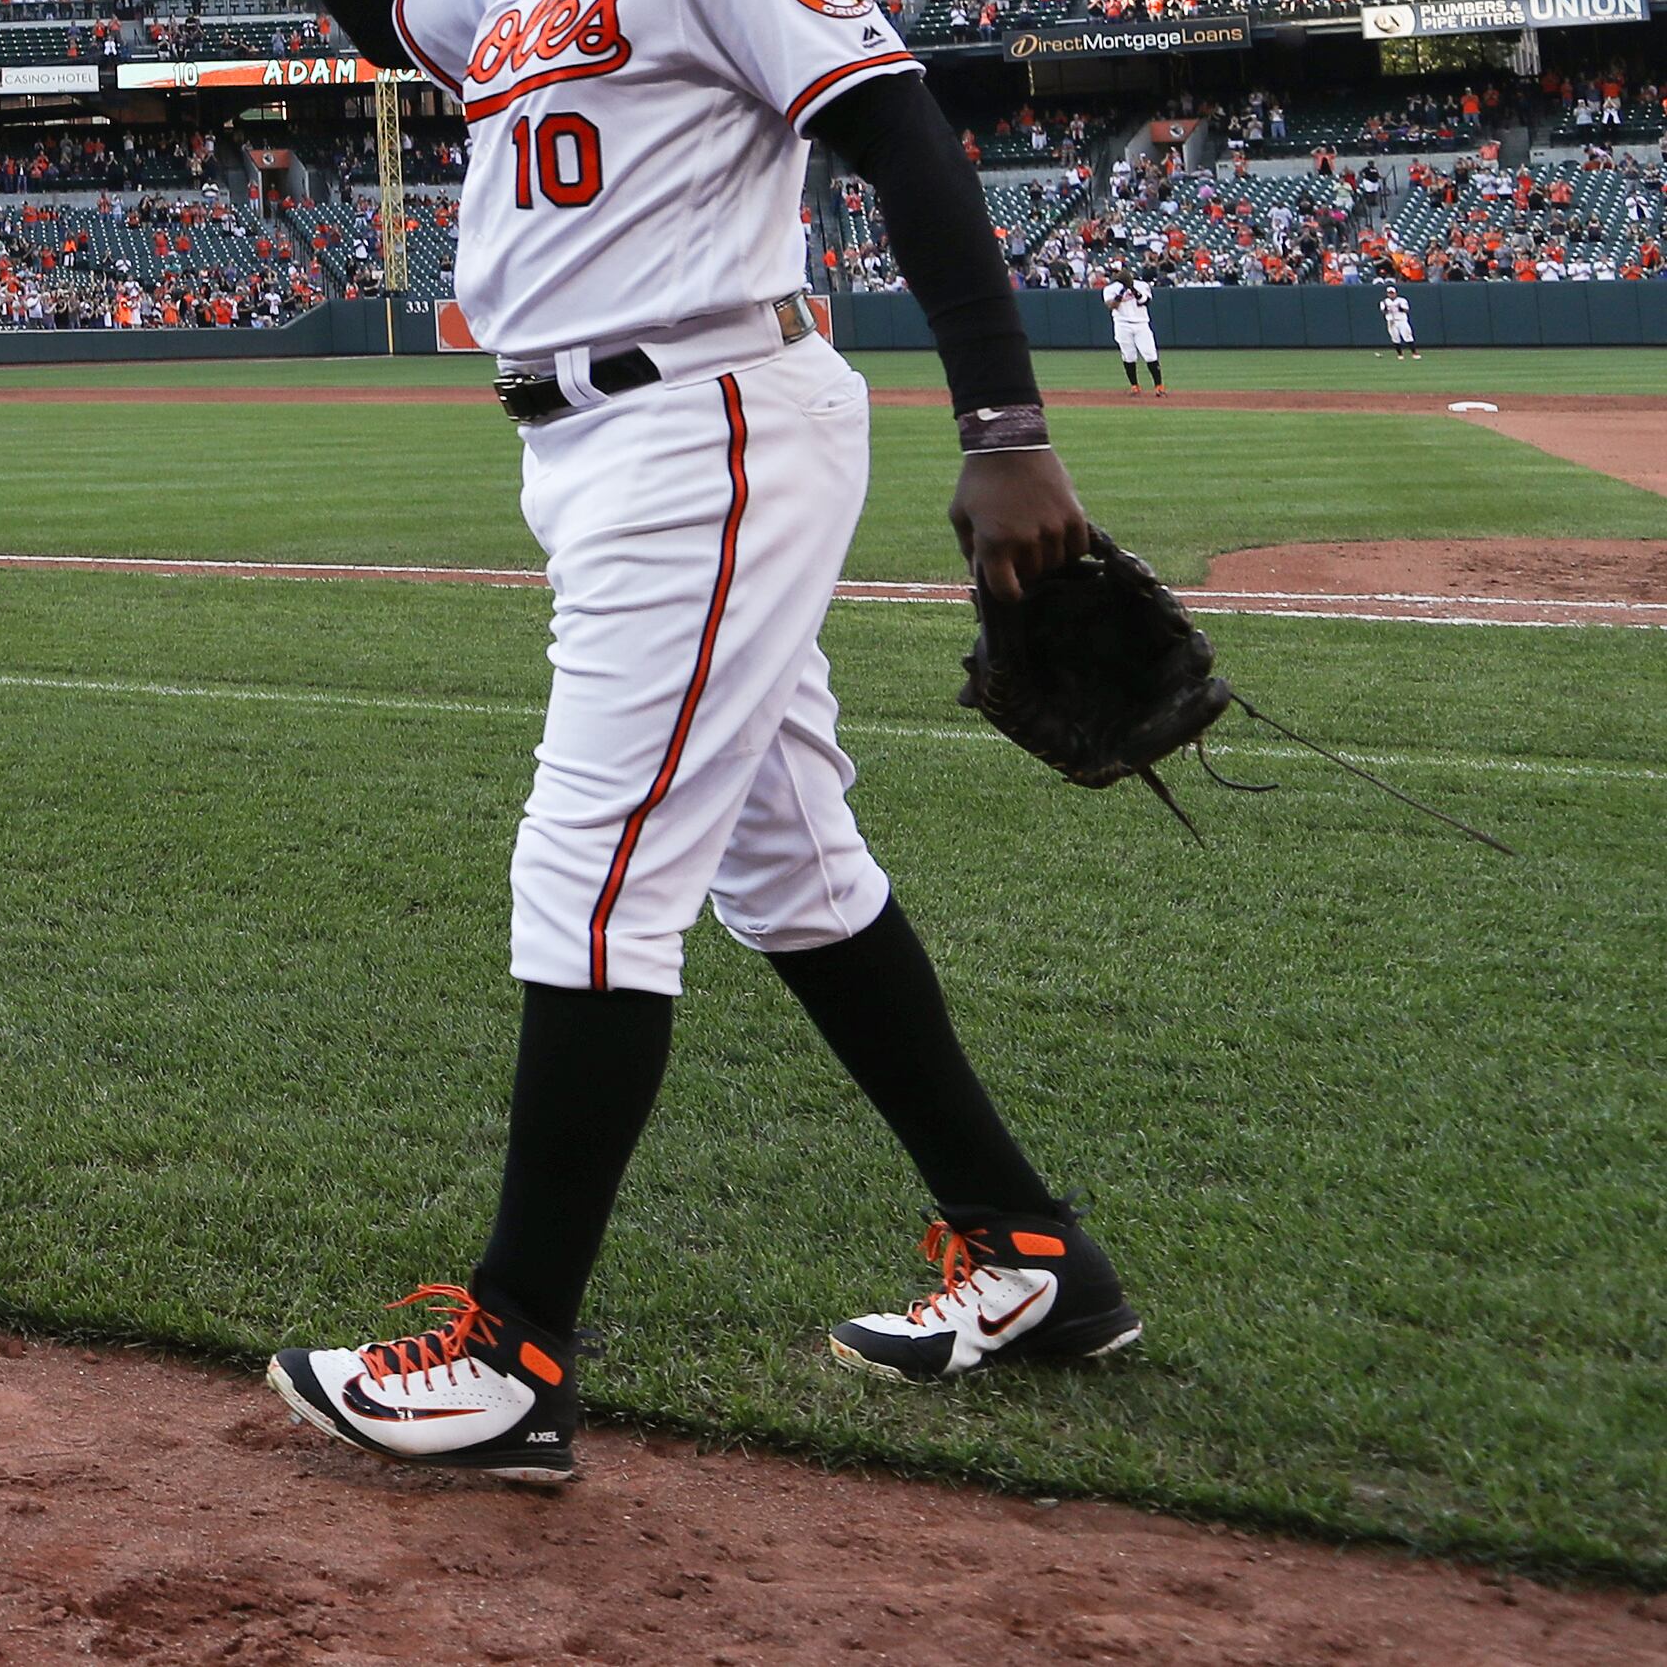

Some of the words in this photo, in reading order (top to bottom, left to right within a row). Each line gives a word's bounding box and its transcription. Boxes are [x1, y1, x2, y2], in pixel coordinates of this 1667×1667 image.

[1420, 0, 1507, 18] PLUMBERS
[1510, 0, 1523, 13] &
[1420, 14, 1458, 30] PIPE
[1461, 11, 1525, 26] FITTERS
[4, 73, 51, 85] CASINO
[57, 72, 94, 84] HOTEL
[172, 62, 199, 86] 10
[262, 58, 357, 85] ADAM
[512, 111, 604, 210] 10
[406, 300, 429, 313] 333
[526, 1430, 560, 1443] AXEL
